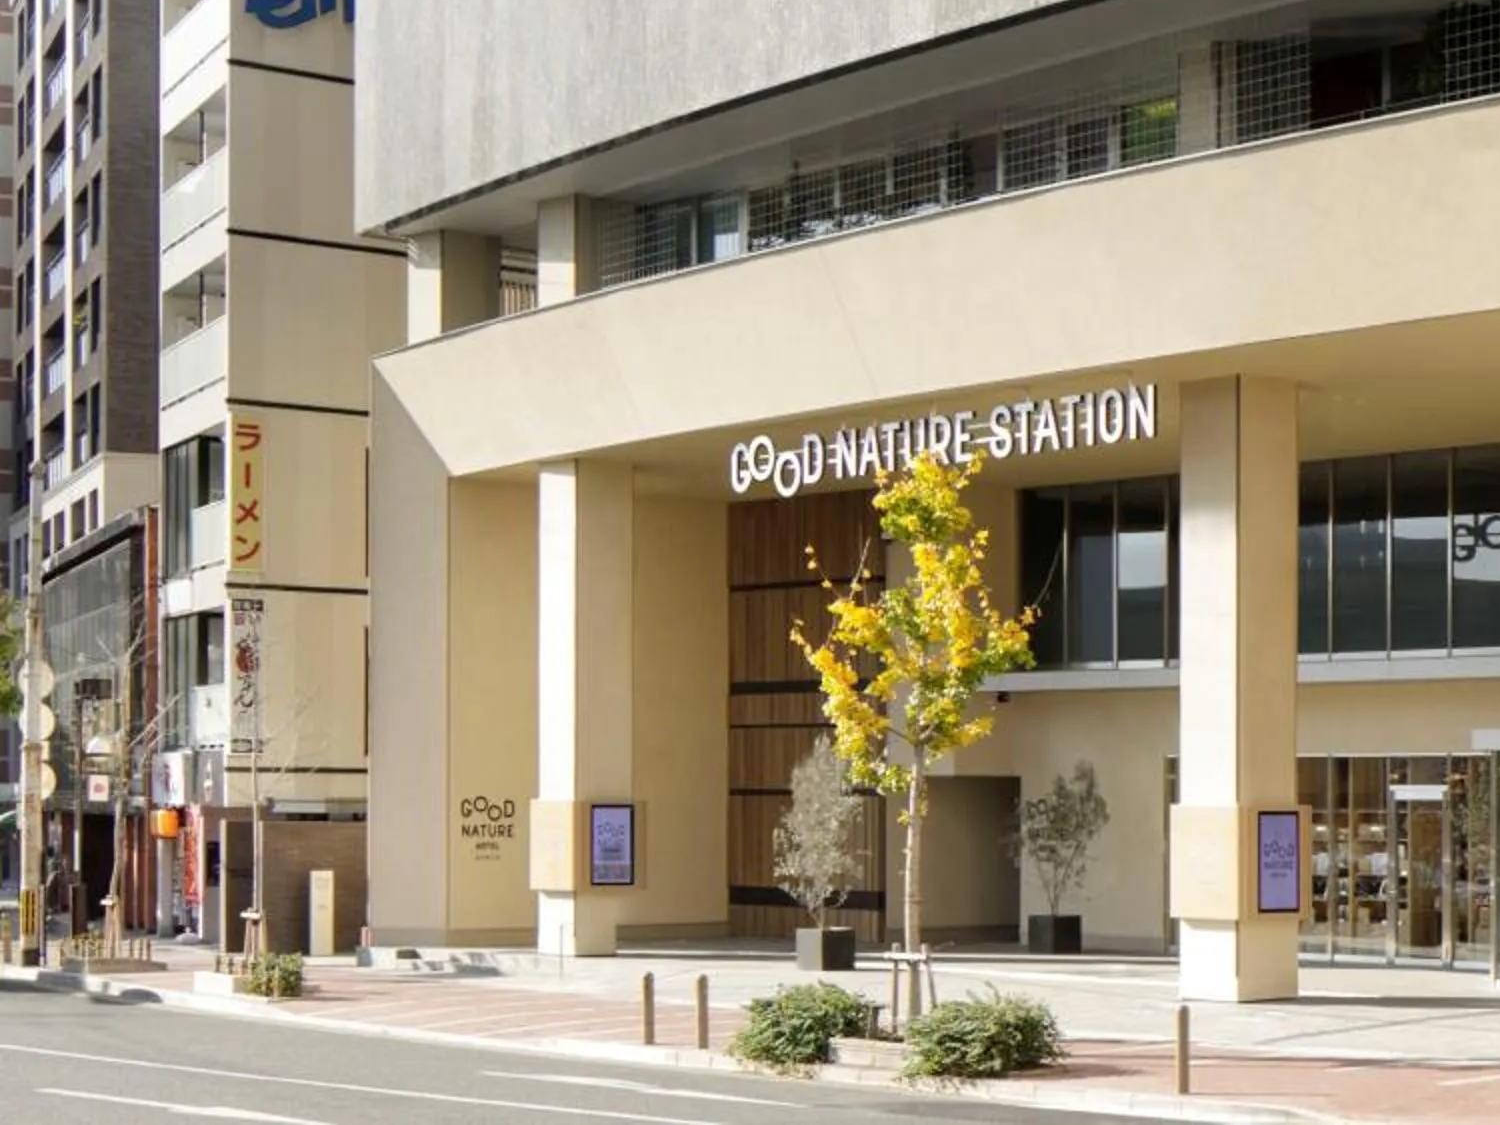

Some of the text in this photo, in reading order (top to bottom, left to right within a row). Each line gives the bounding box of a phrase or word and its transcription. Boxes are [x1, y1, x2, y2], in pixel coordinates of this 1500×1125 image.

[730, 383, 1157, 498] GOOD NATURE STATION
[235, 422, 262, 562] ラーメン
[460, 795, 516, 822] GOOD
[461, 824, 514, 838] NATURE
